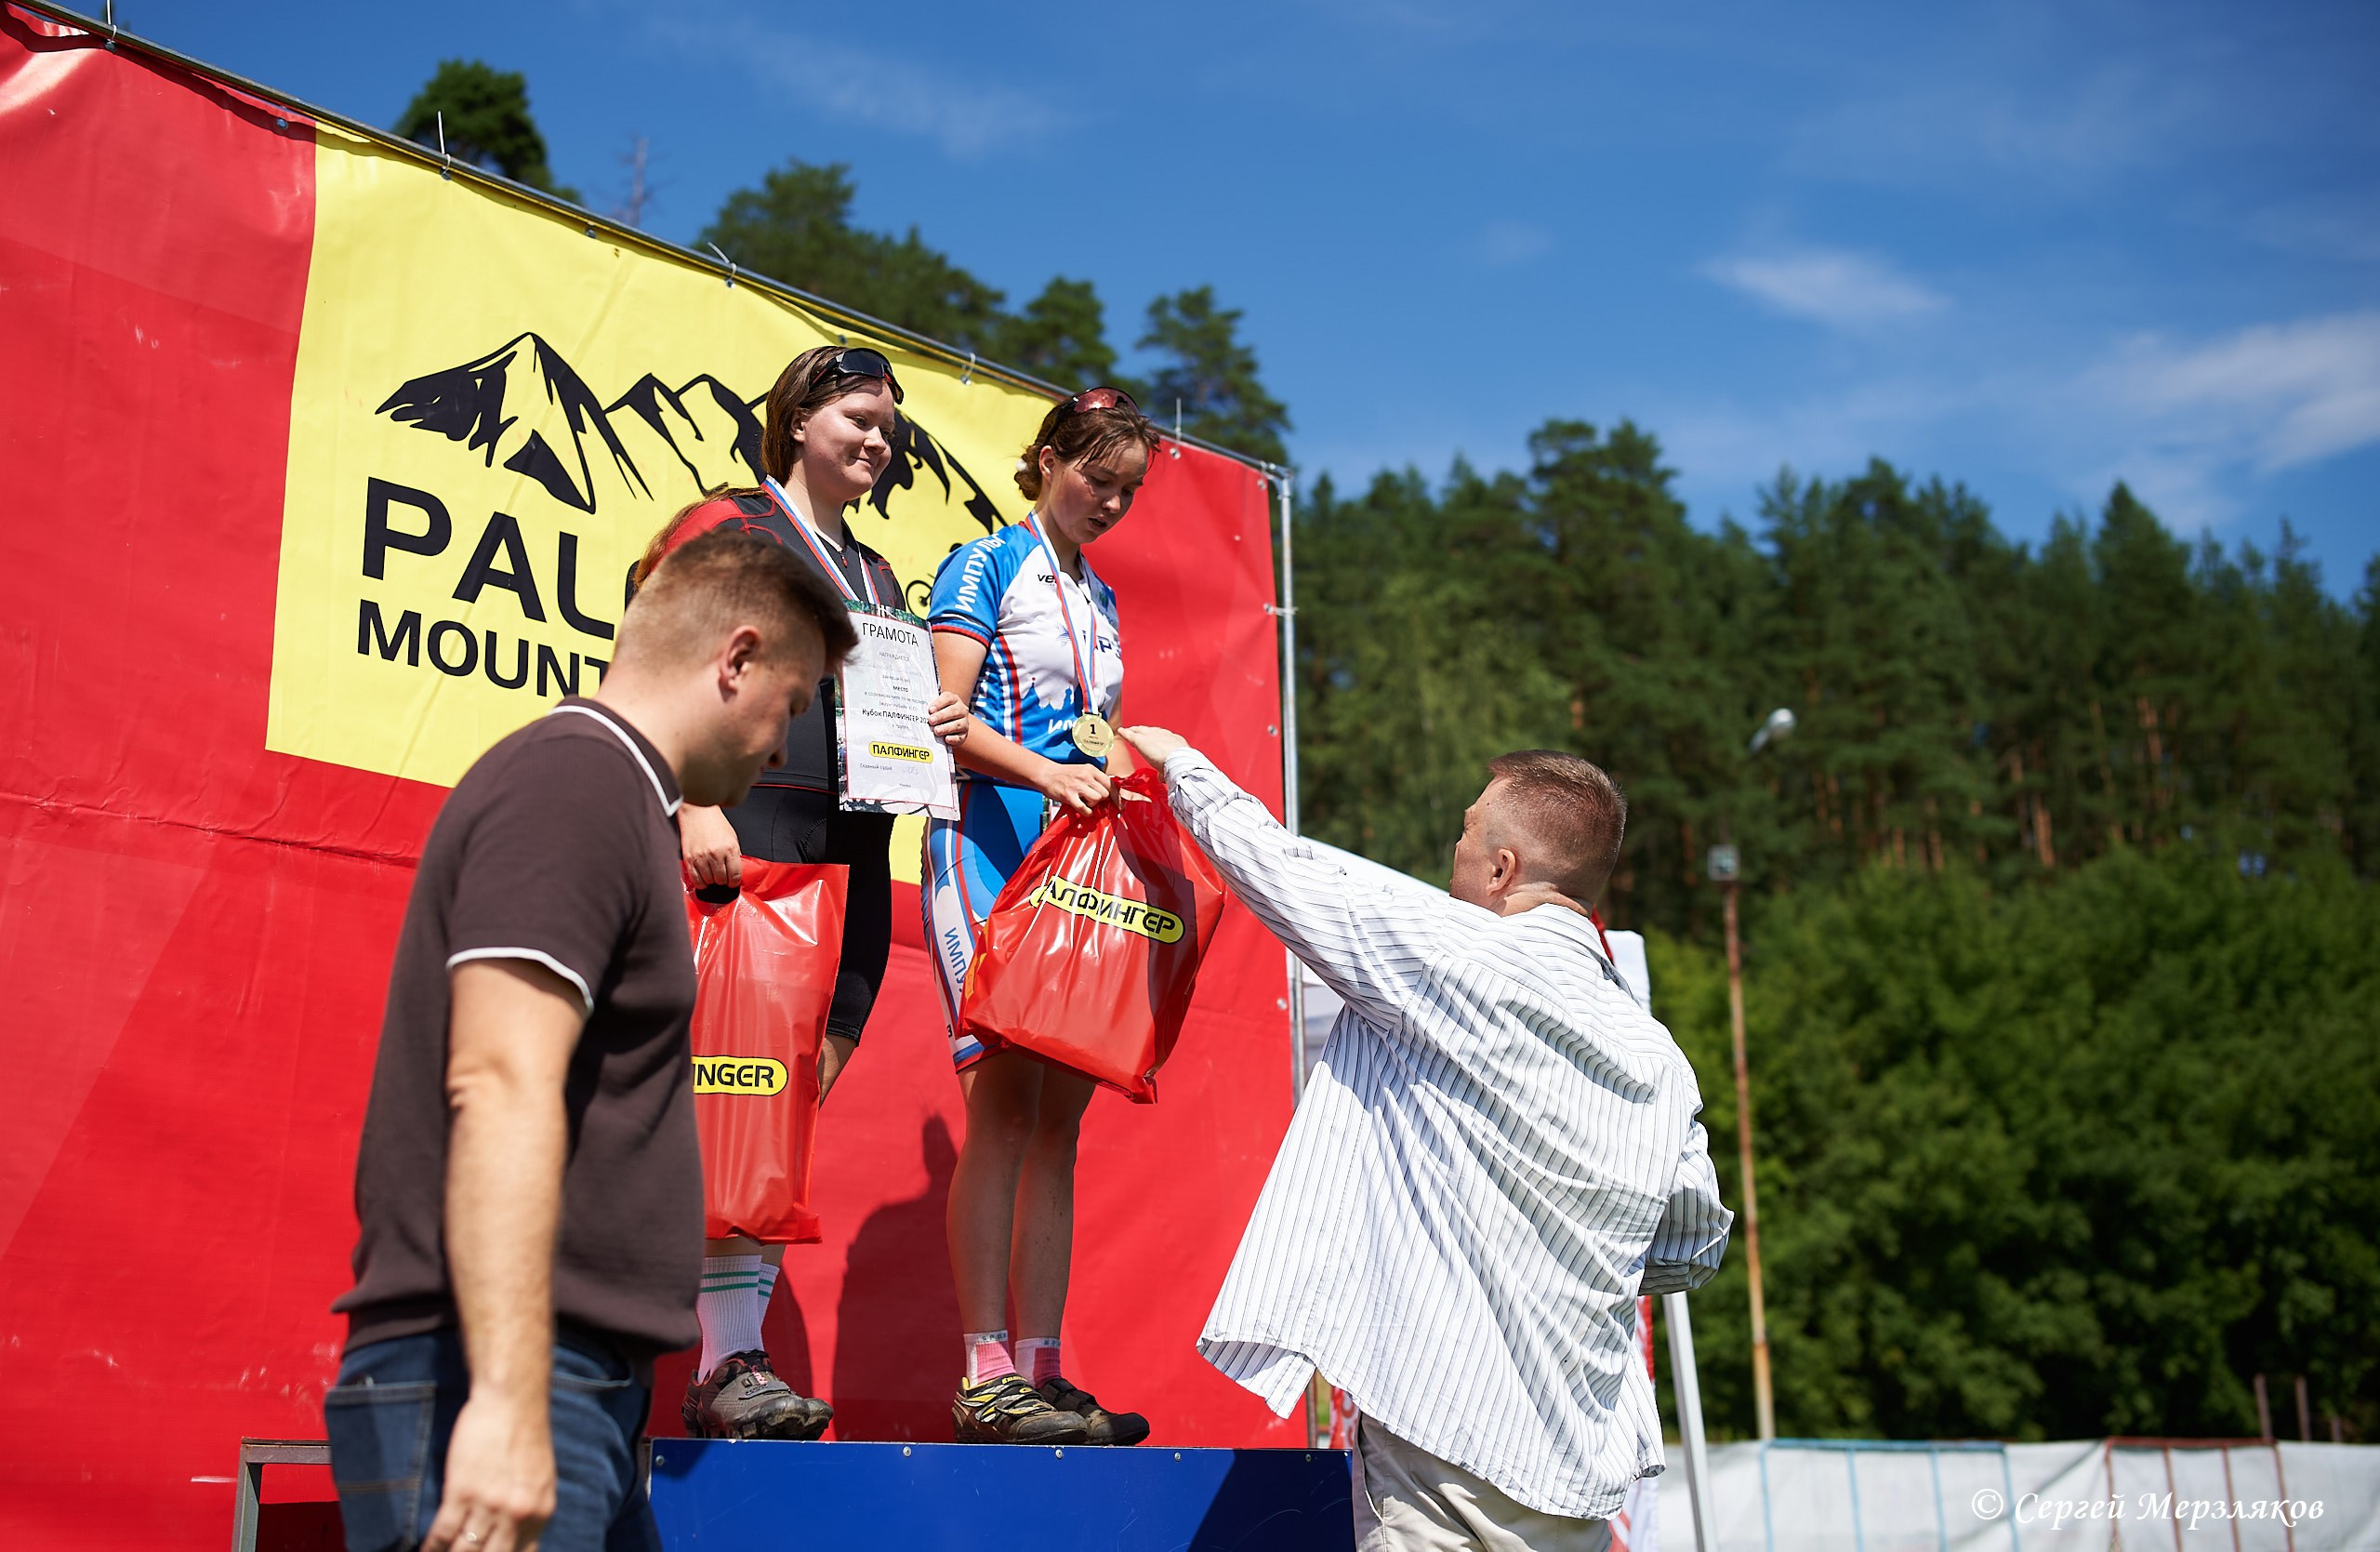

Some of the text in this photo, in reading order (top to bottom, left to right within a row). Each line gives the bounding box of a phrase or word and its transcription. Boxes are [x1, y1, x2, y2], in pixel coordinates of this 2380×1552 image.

[363, 476, 615, 641] PAL
[955, 533, 1006, 613] ИМПУЛЬС
[358, 599, 612, 698] MOUNT
[862, 622, 919, 647] ГРАМОТА
[862, 709, 882, 718] Кубок
[882, 710, 919, 723] ПАЛФИНГЕР
[1090, 723, 1096, 735] 1
[872, 744, 931, 761] ПАЛФИНГЕР
[1038, 881, 1176, 935] АЛФИНГЕР
[945, 927, 967, 993] ИМПУ
